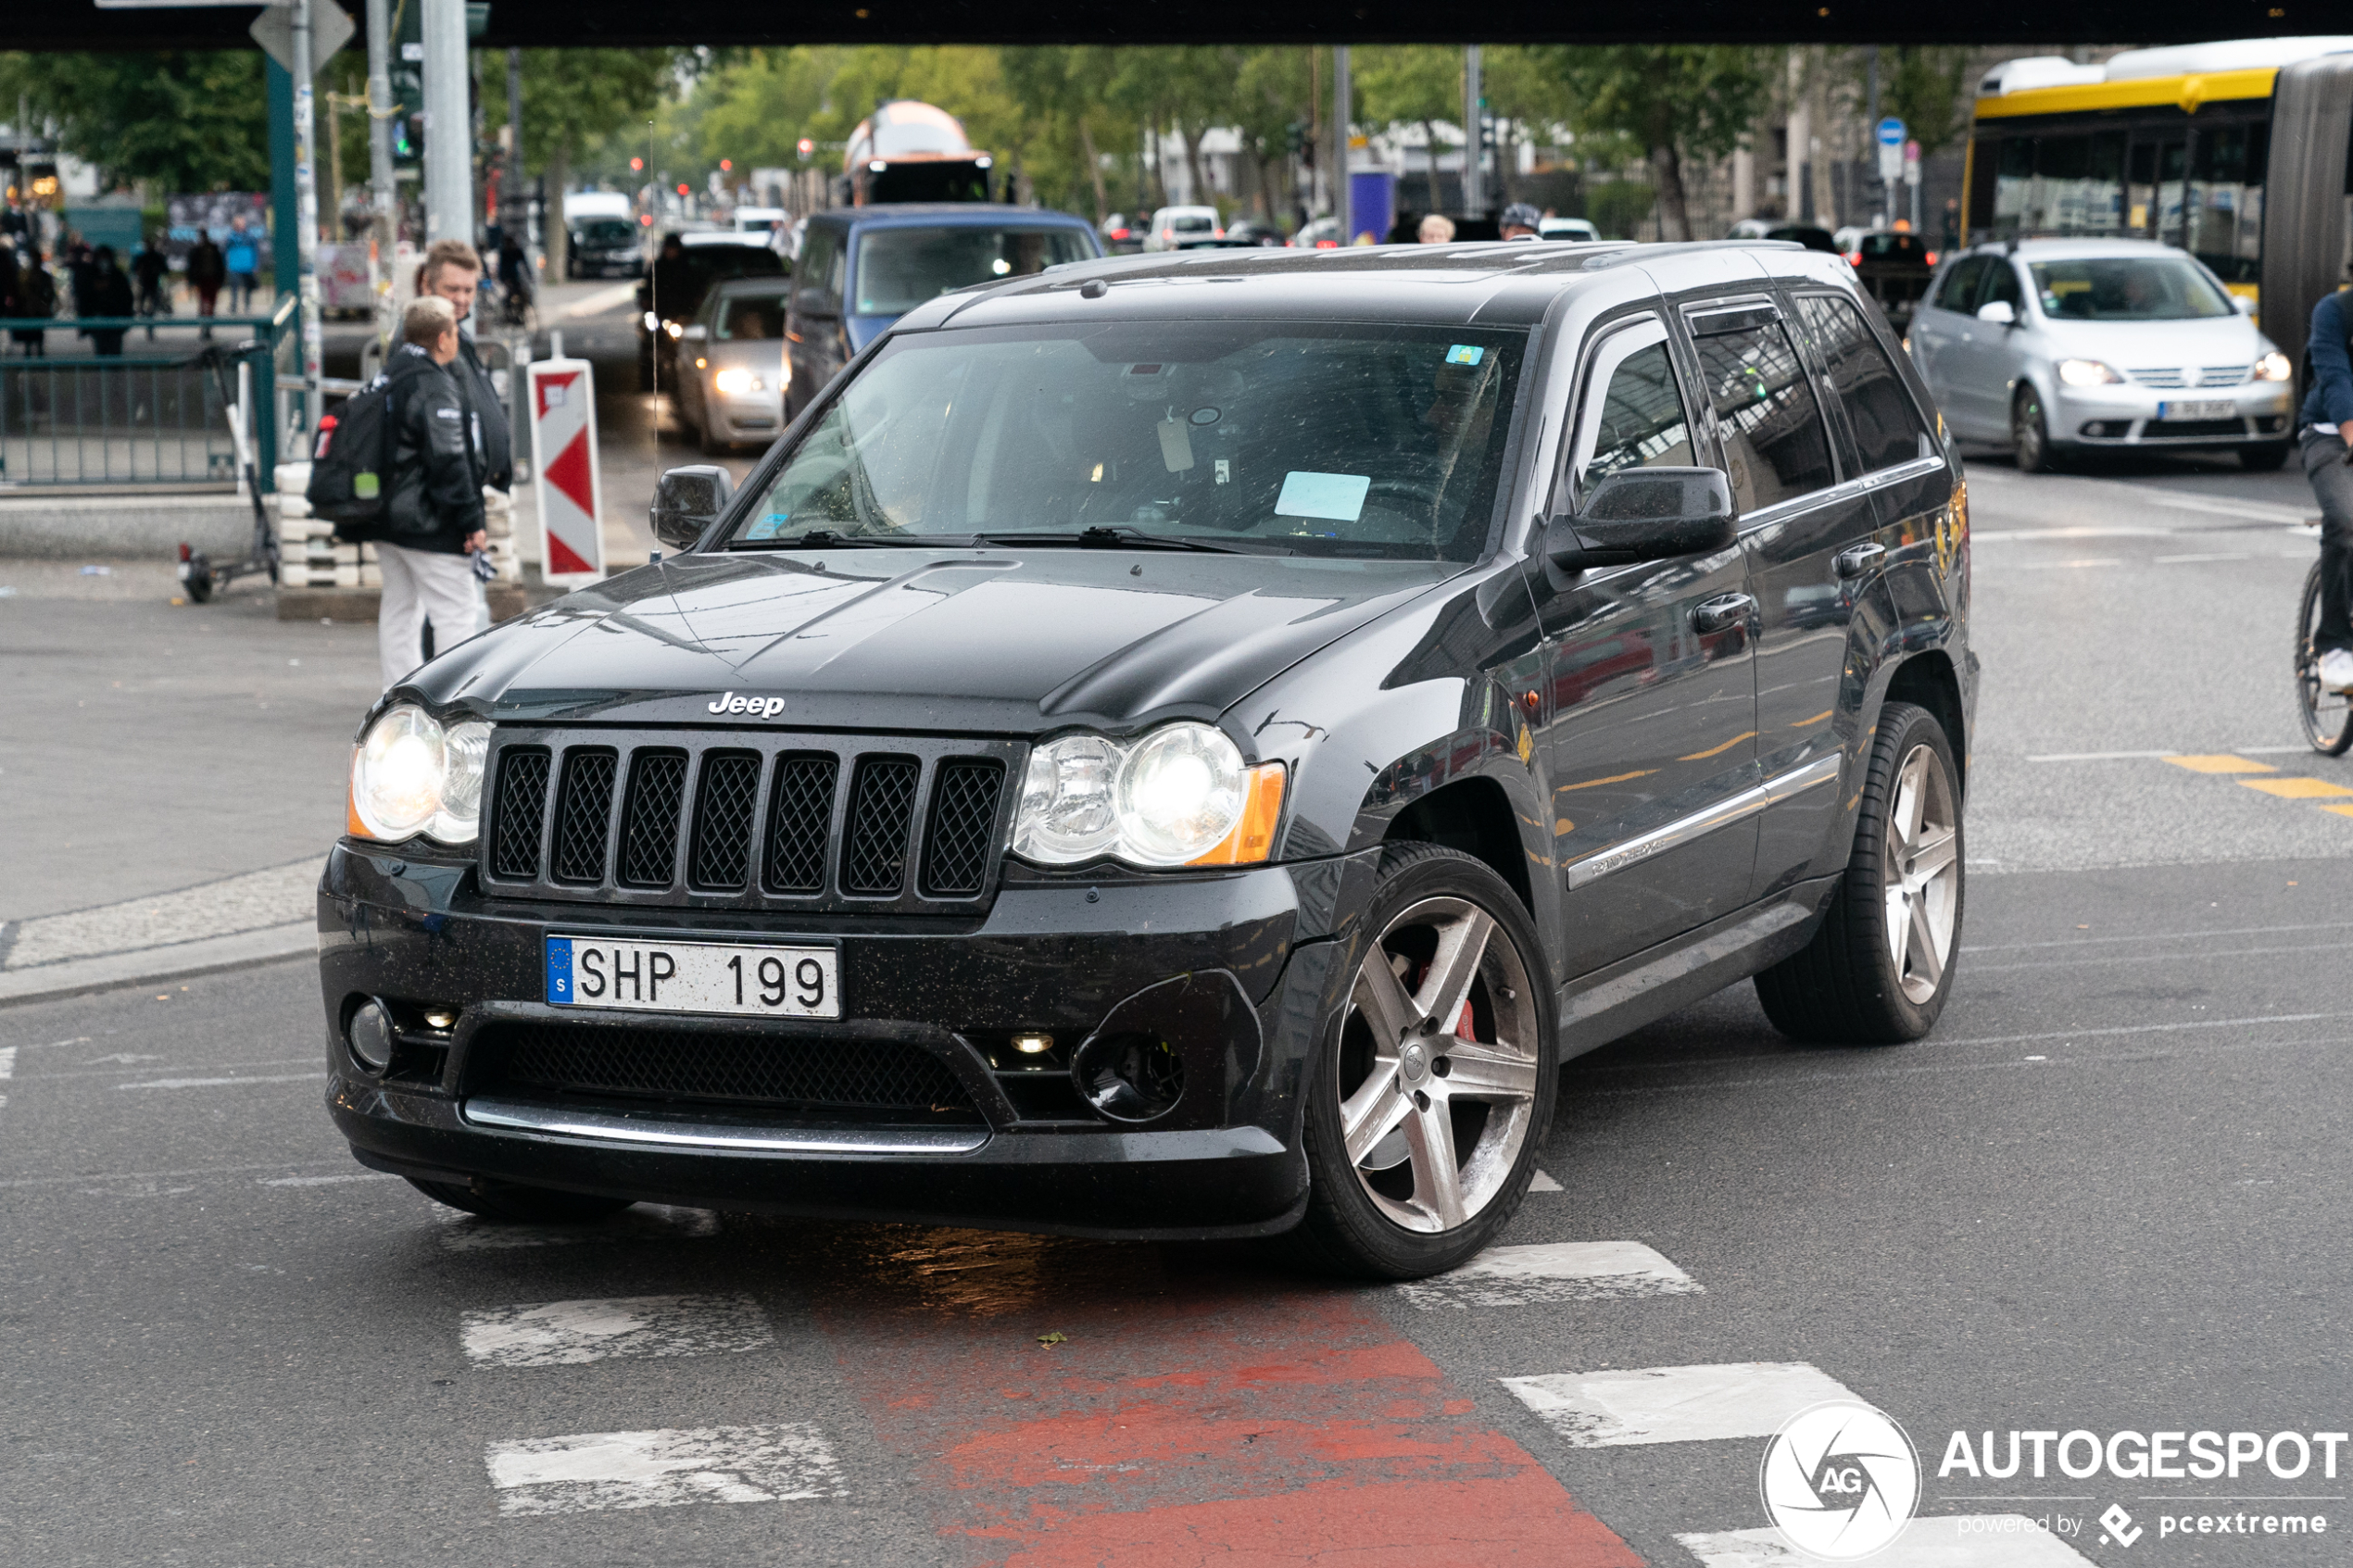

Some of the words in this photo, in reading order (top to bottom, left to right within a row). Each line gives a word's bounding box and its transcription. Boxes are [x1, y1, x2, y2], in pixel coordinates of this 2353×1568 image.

[708, 691, 786, 720] Jeep
[1592, 854, 1623, 876] GRAND
[556, 978, 566, 993] S
[581, 947, 676, 1001] SHP
[726, 955, 825, 1009] 199
